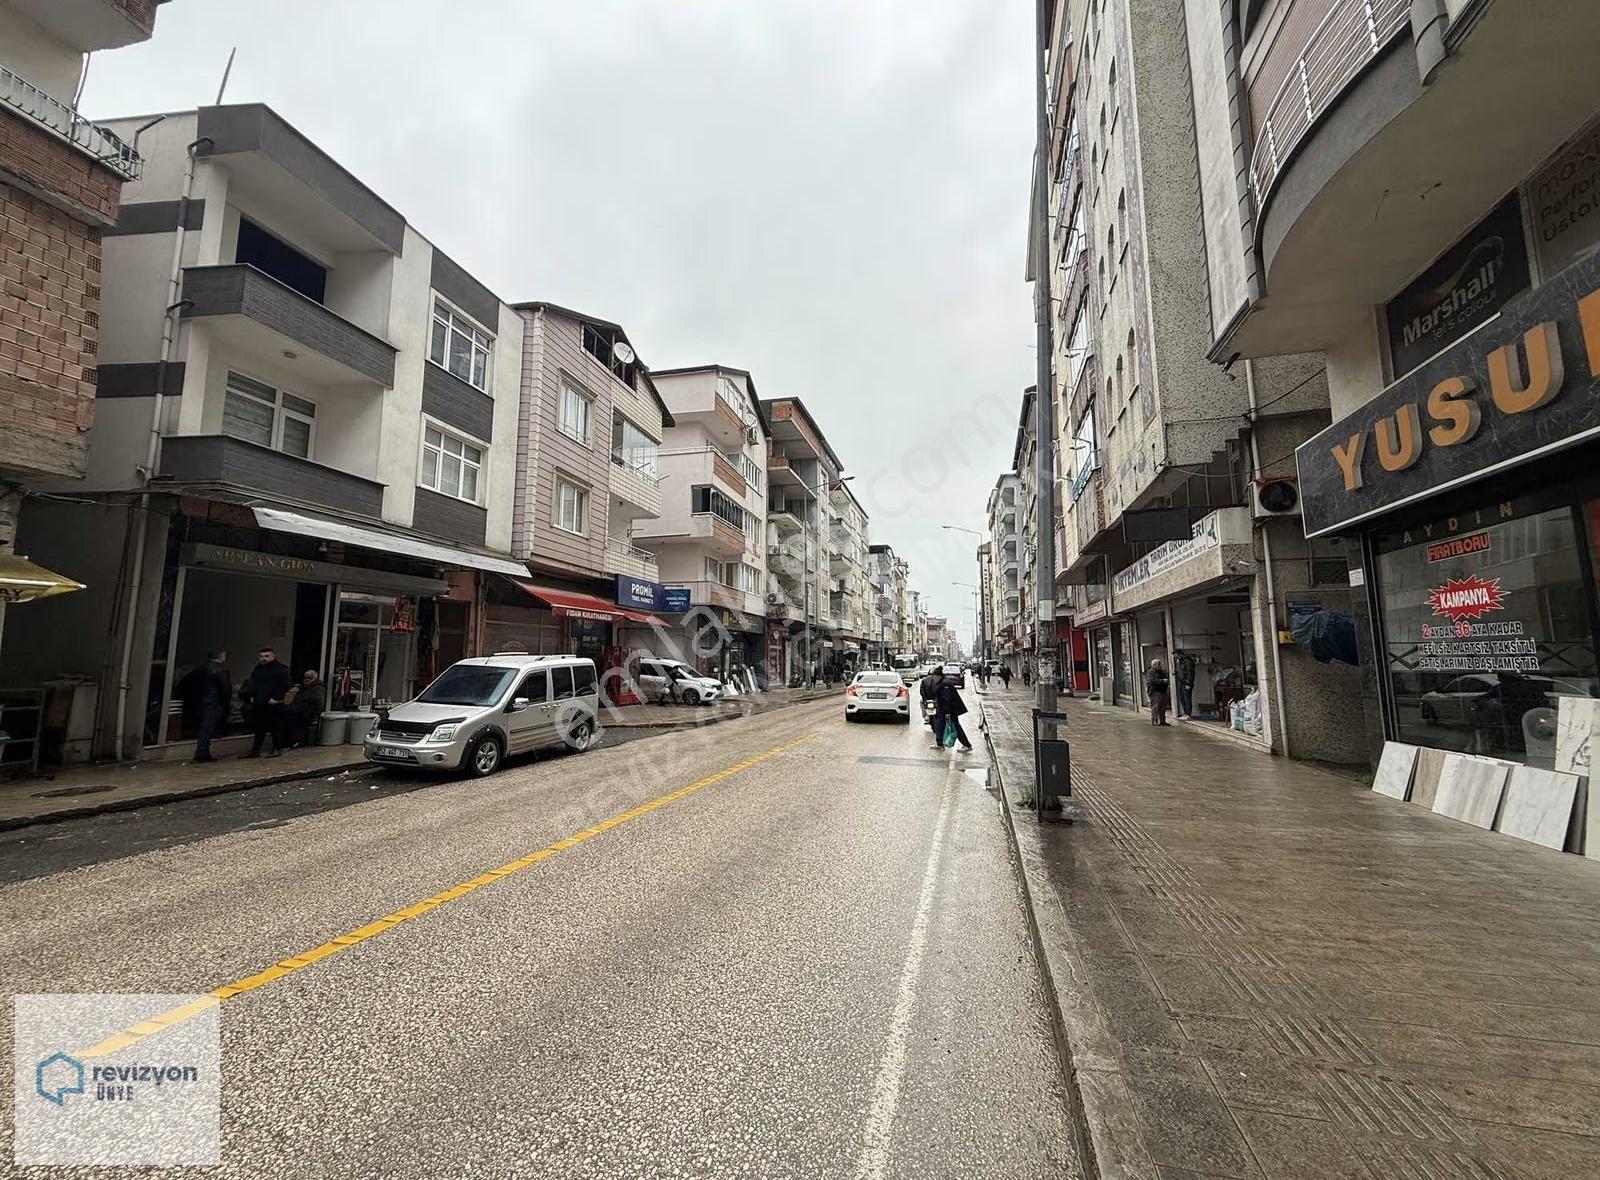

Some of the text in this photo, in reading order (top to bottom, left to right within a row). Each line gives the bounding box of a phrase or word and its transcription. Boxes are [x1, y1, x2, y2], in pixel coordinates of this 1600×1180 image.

[1402, 260, 1495, 348] Marshall
[1403, 502, 1513, 544] AYDIN
[631, 583, 653, 598] PROMİL
[1440, 587, 1490, 608] KAMPANYA
[1423, 621, 1523, 639] 2 AYDAN 36 AYA KADAR
[1417, 637, 1536, 655] KEFİLSİZ KARTSIZ TAKSİTLİ
[1419, 655, 1540, 674] SATIŞLARIMIZ BAŞLAMIŞTIR
